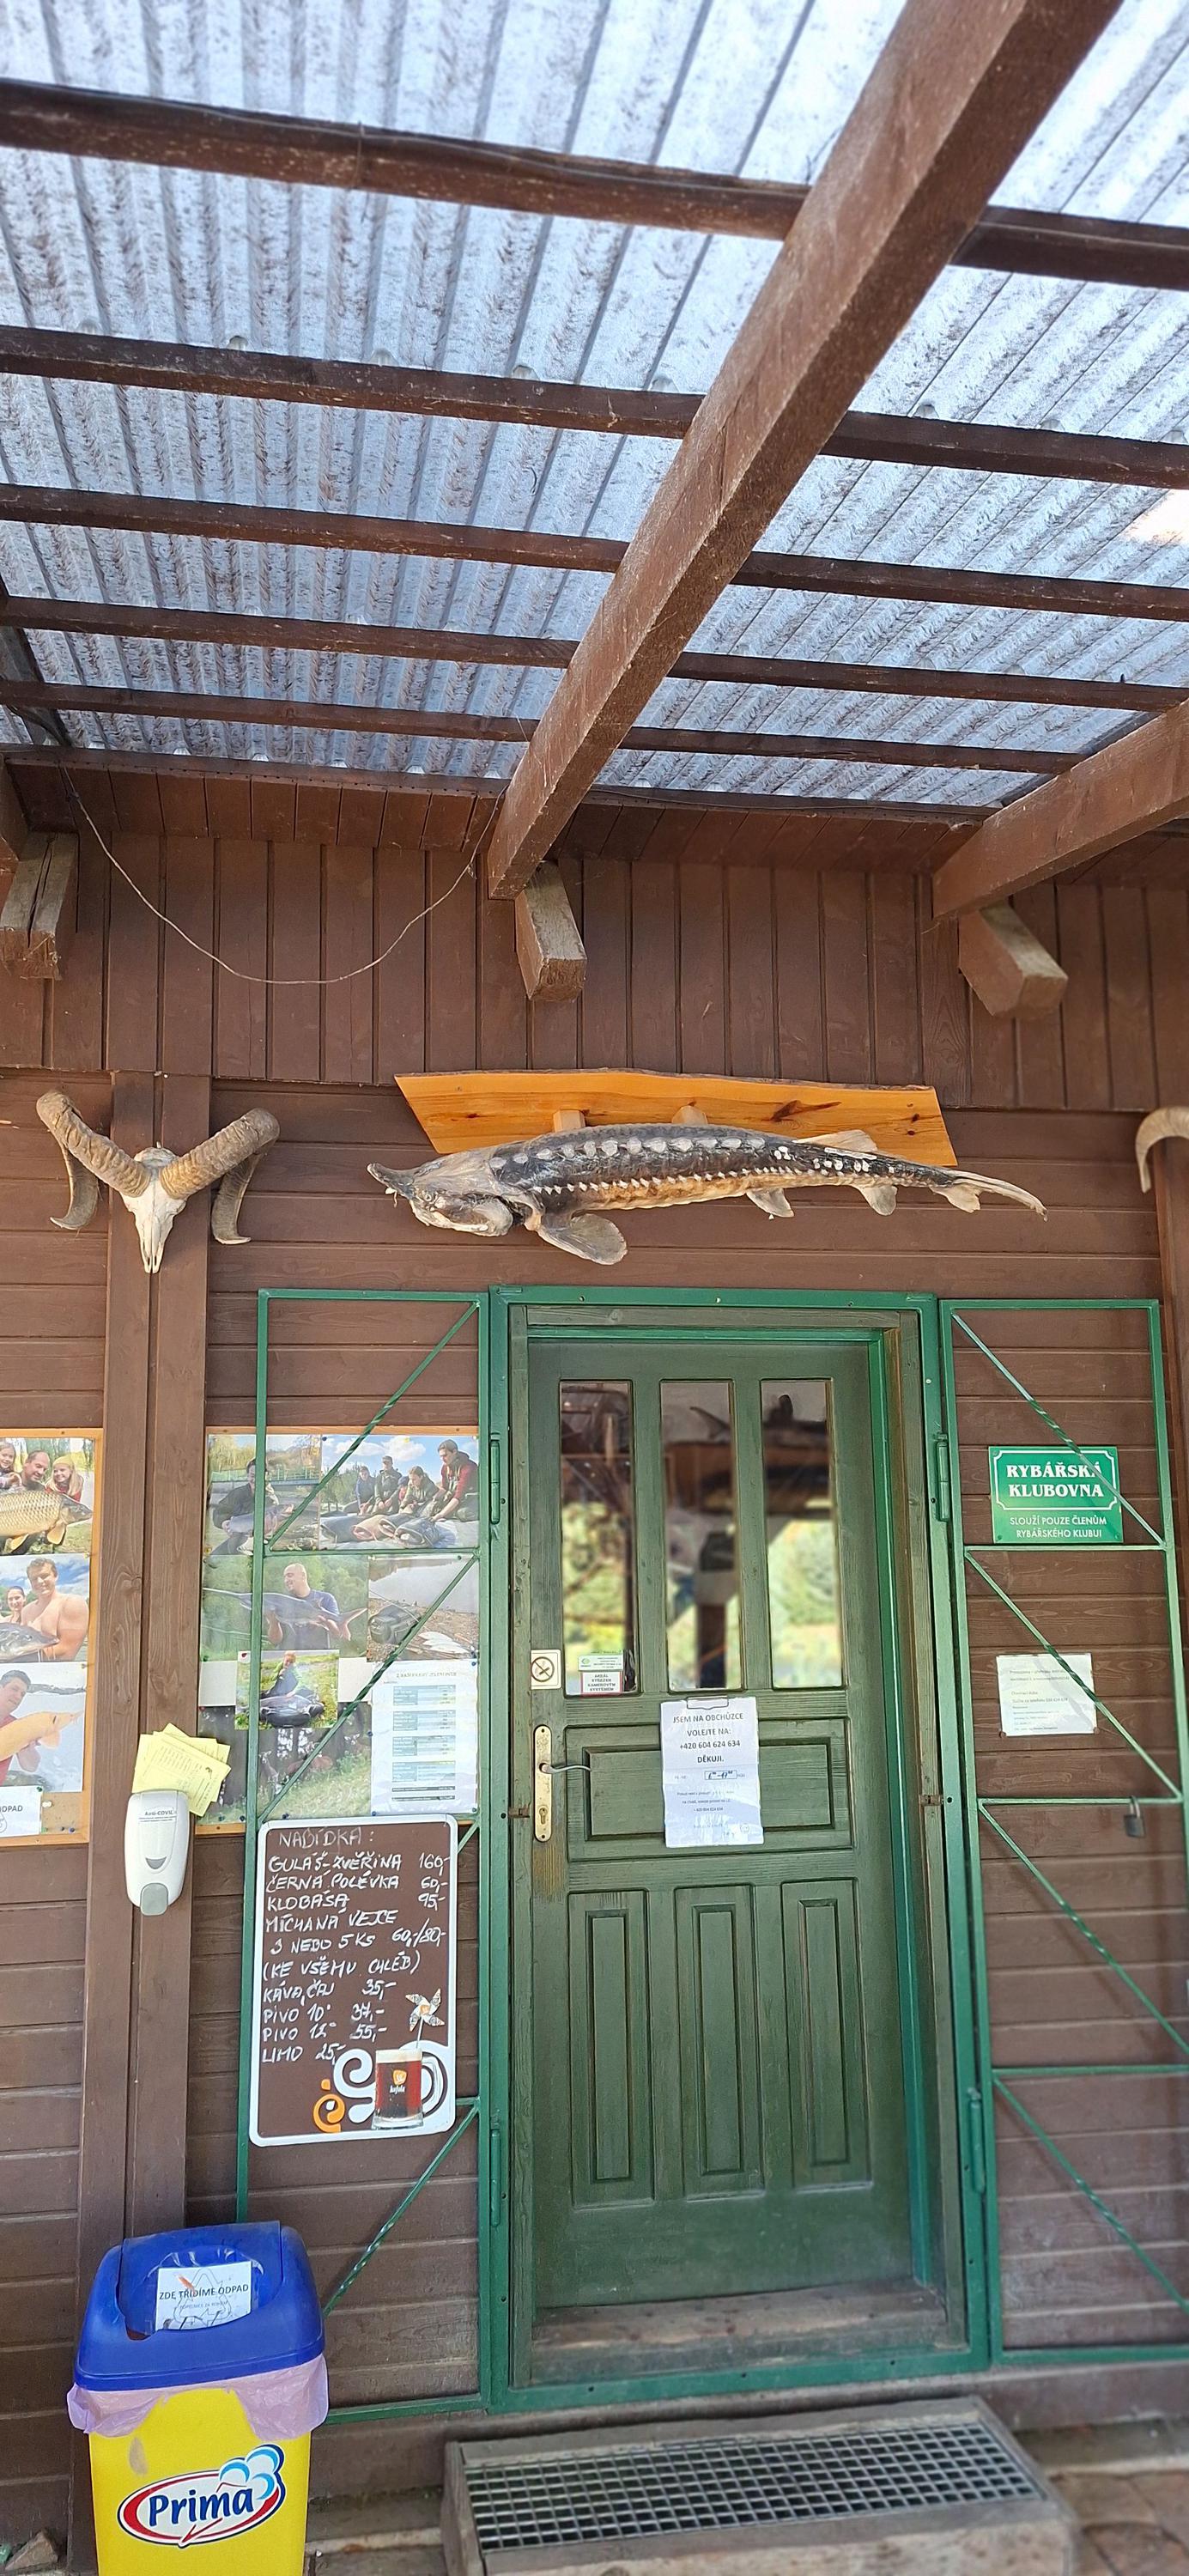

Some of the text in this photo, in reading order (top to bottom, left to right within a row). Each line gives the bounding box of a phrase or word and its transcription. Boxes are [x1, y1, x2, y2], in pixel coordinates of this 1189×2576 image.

[1009, 1484, 1104, 1498] KLUBOVNA
[1010, 1515, 1107, 1525] SLOUŽÍ POUZE ČLENŮM
[1016, 1528, 1071, 1538] RYBÁŘSKÉHO
[705, 1712, 744, 1721] OBCHŮZCE
[687, 1728, 716, 1737] VOLEJTE
[697, 1754, 725, 1763] DĚKUJI.
[266, 1870, 331, 1893] ČERNÁ
[331, 1870, 399, 1890] POLÉVKA
[267, 1890, 350, 1911] KLOBÁSA
[266, 1908, 399, 1933] MÍCHANÁ VEJCE
[290, 1939, 331, 1954] NEBO
[263, 2006, 299, 2023] PIVO
[263, 2027, 298, 2042] PIVO
[262, 2045, 303, 2063] LIMO
[218, 2284, 249, 2294] ODPAD
[149, 2488, 254, 2527] Prima
